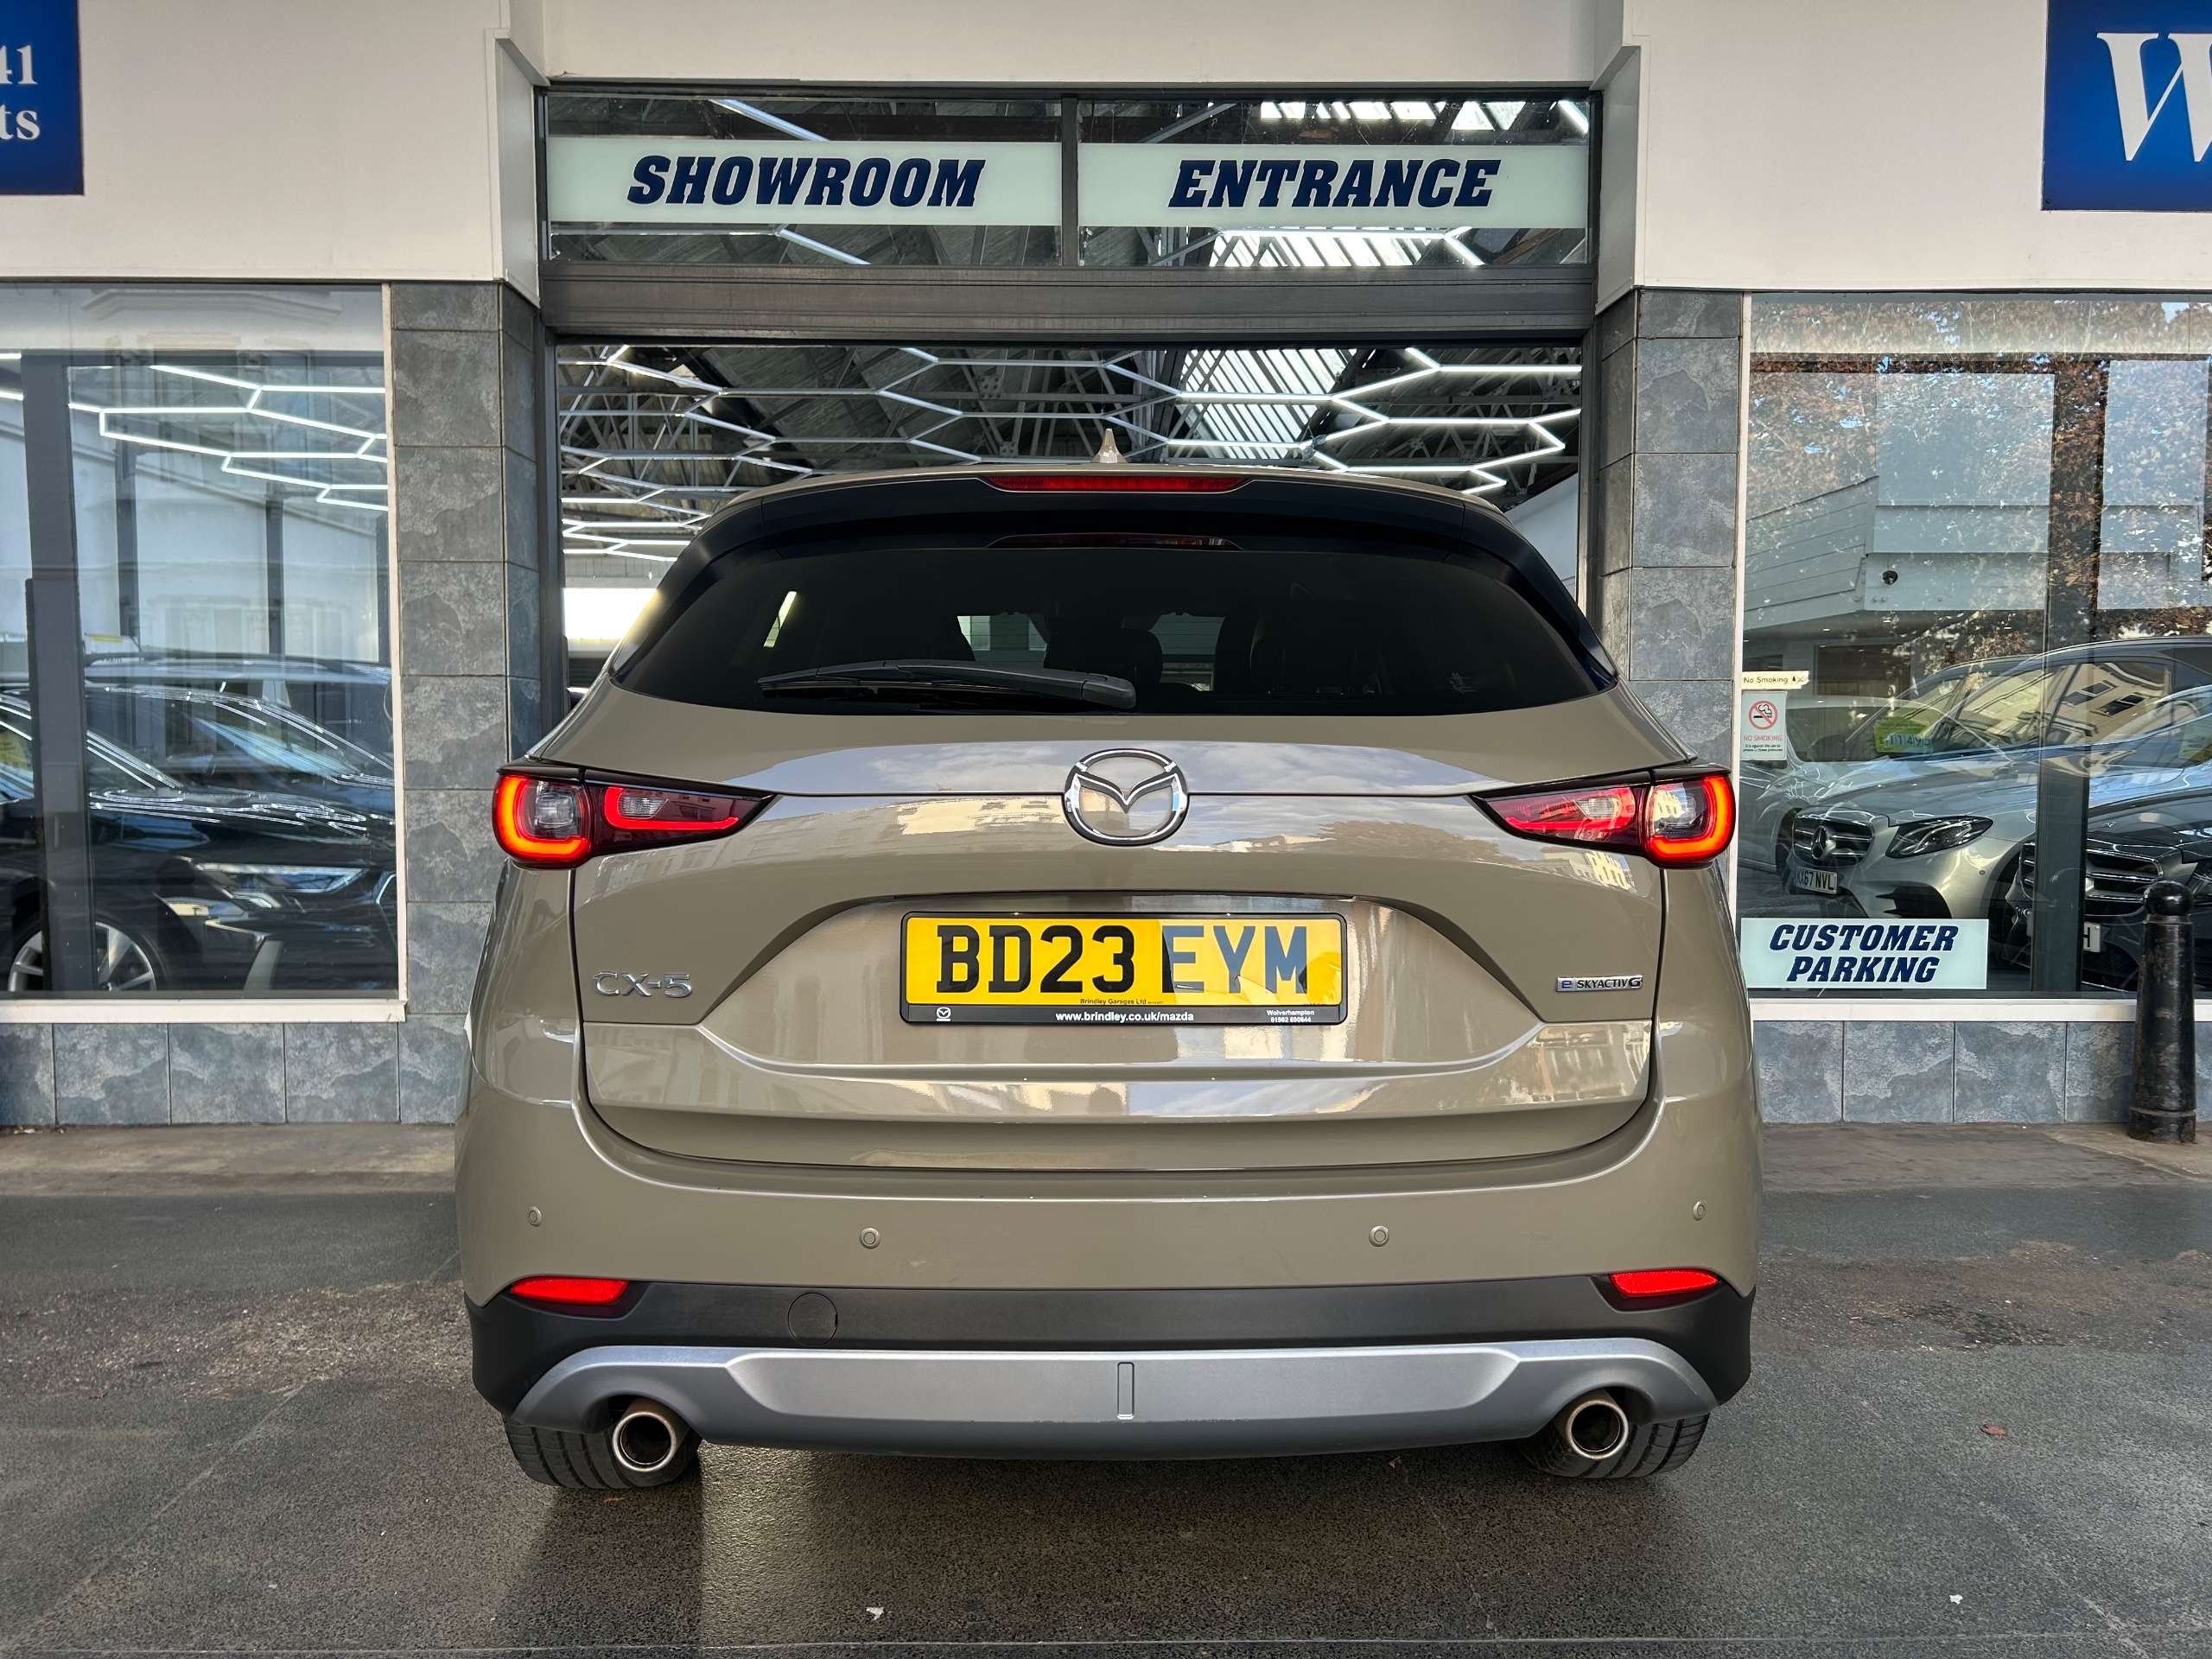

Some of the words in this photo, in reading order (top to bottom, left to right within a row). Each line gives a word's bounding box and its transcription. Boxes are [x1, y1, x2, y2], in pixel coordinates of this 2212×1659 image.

[626, 155, 986, 207] SHOWROOM
[1168, 158, 1501, 208] ENTRANCE
[1757, 676, 1789, 684] Smoking
[1815, 872, 1834, 890] NVL
[1769, 924, 1959, 951] CUSTOMER
[937, 925, 1135, 993] BD23
[1162, 925, 1307, 994] EYM
[1786, 956, 1940, 982] PARKING
[594, 971, 692, 998] CX-5
[1055, 1011, 1194, 1023] www.brindley.co.uk/mazda
